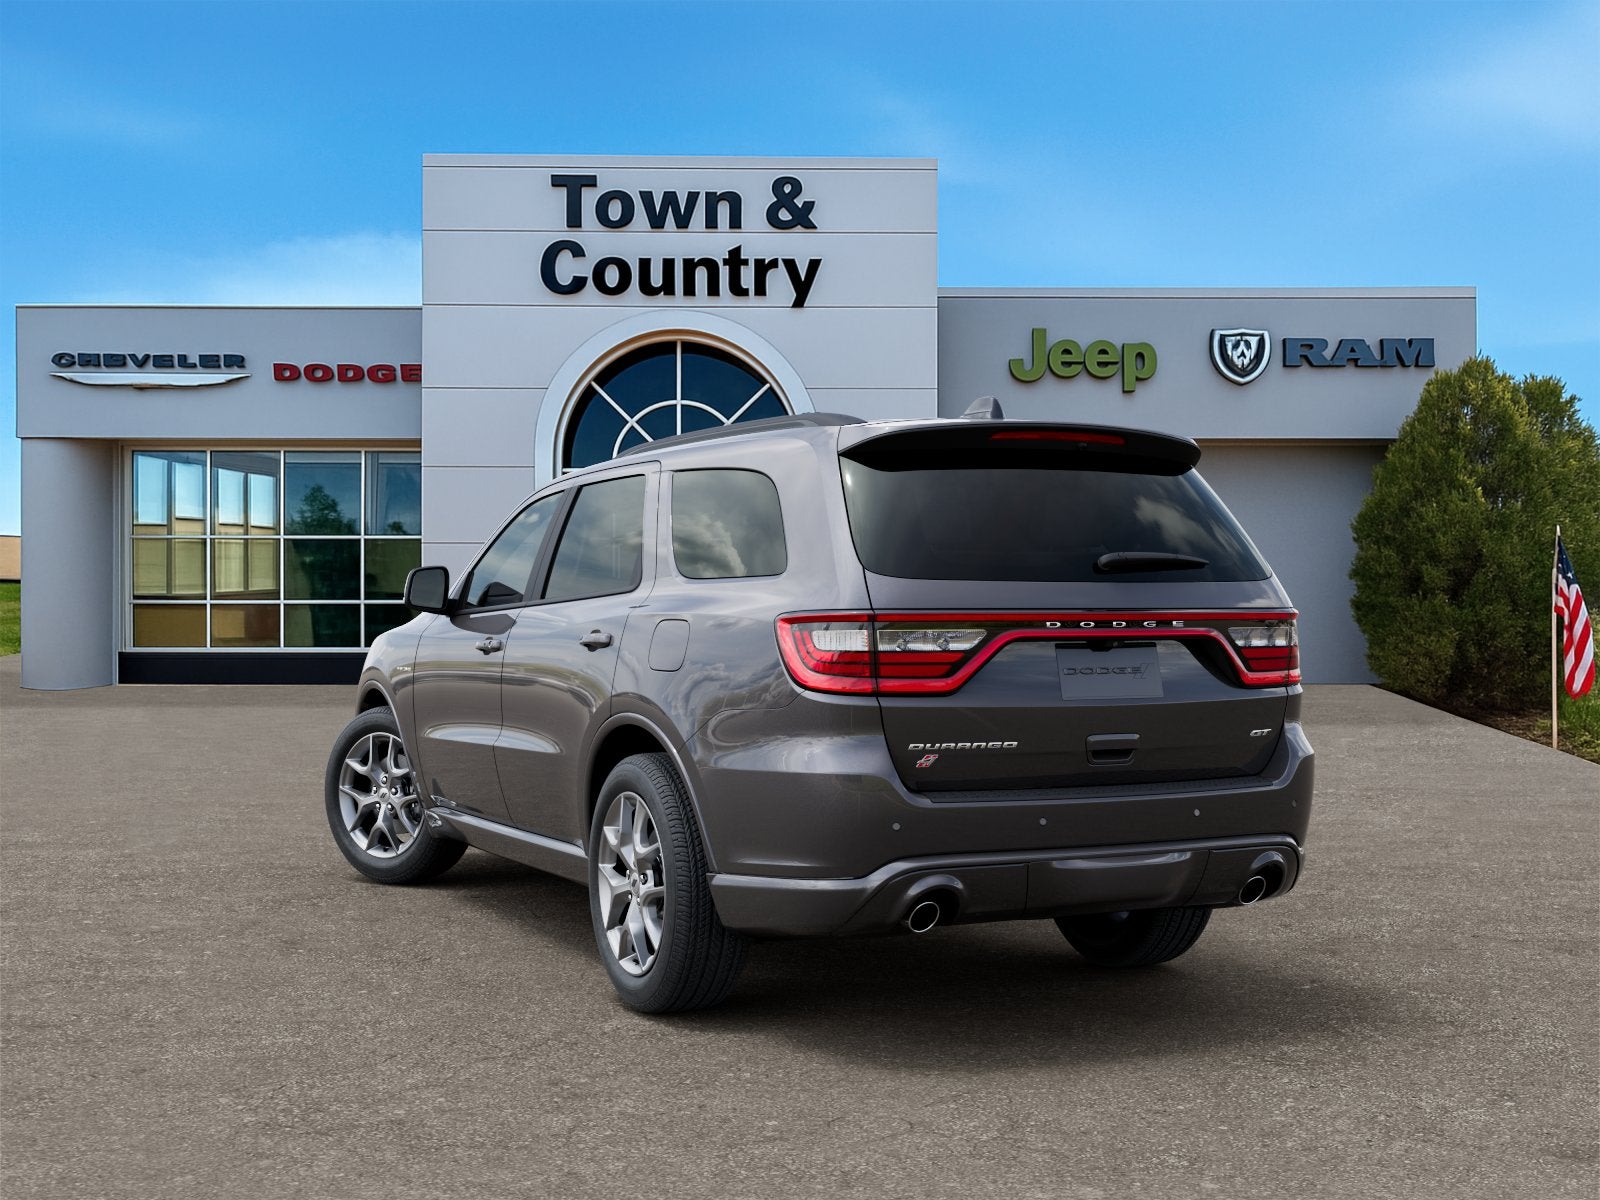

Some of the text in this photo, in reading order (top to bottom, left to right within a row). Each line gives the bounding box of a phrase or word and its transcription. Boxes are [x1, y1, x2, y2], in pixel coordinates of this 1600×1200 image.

[550, 174, 818, 230] Town &
[540, 239, 822, 308] Country
[1008, 327, 1158, 393] Jeep
[1282, 337, 1436, 368] RAM
[273, 363, 422, 383] DODGE
[1045, 620, 1185, 628] DODGE
[1063, 666, 1143, 676] DODGE
[1249, 728, 1272, 737] GT
[907, 741, 1019, 751] DURANGO
